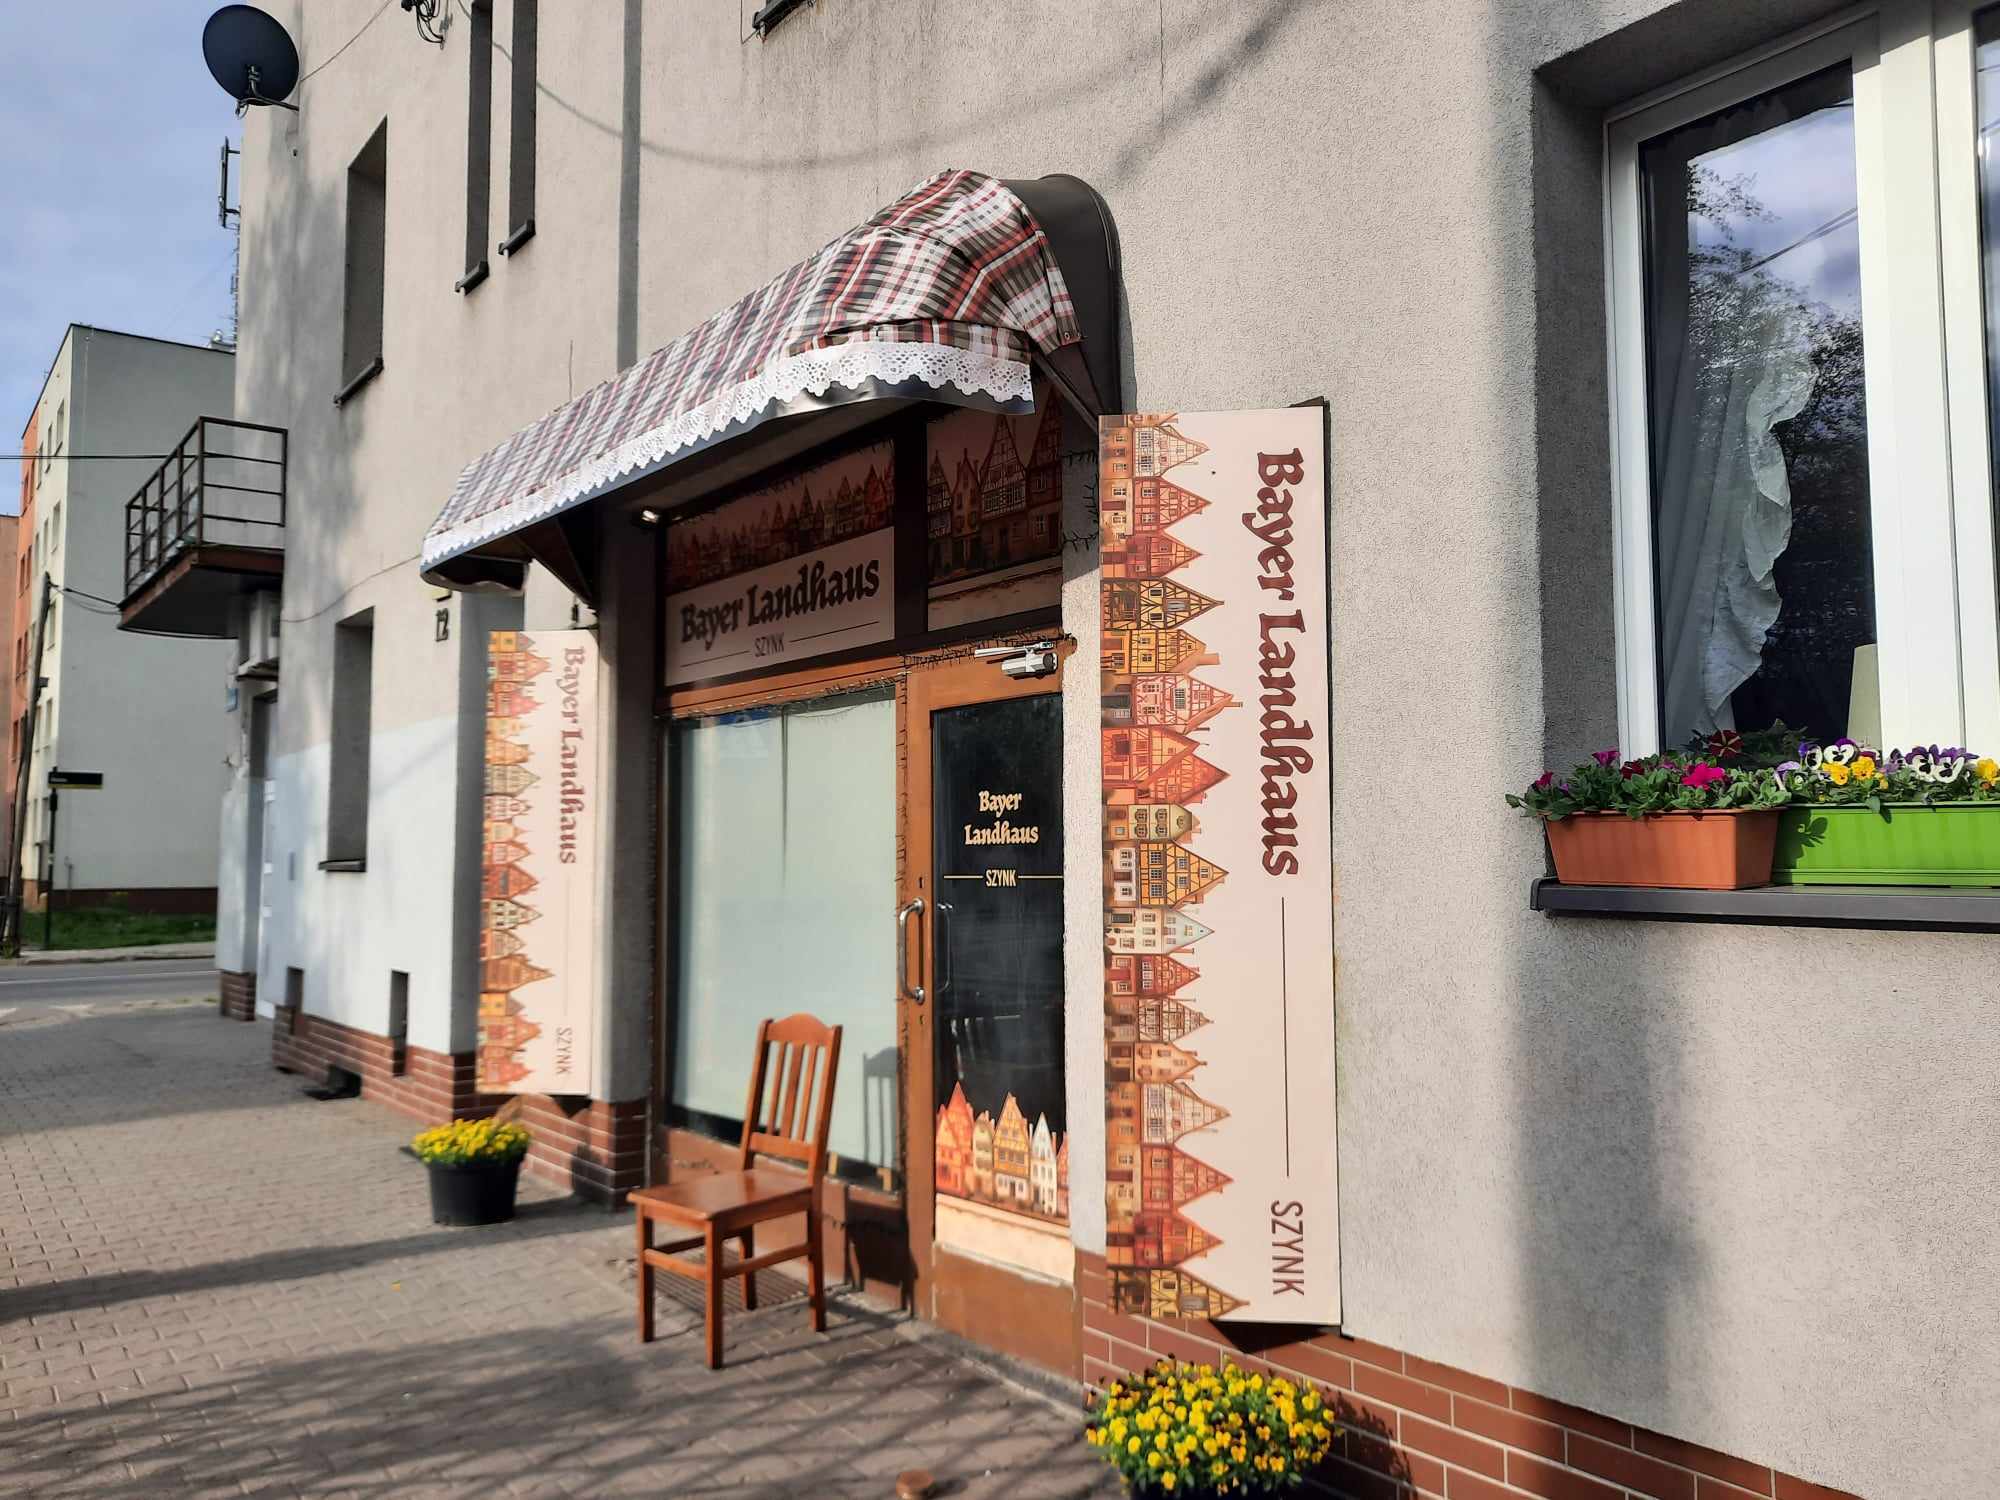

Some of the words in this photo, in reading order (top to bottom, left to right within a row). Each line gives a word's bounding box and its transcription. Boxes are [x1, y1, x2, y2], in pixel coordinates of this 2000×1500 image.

[1242, 448, 1304, 600] Bayer
[680, 597, 743, 650] Bayer
[746, 558, 880, 626] Landhaus
[754, 632, 785, 657] SZYNK
[556, 647, 585, 724] Bayer
[1258, 609, 1314, 876] Landhaus
[560, 728, 586, 865] Landhaus
[964, 820, 1039, 845] Landhaus
[978, 790, 1022, 818] Bayer
[985, 869, 1017, 887] SZYNK
[555, 1027, 573, 1075] SZYNK
[1270, 1199, 1305, 1296] SZYNK
